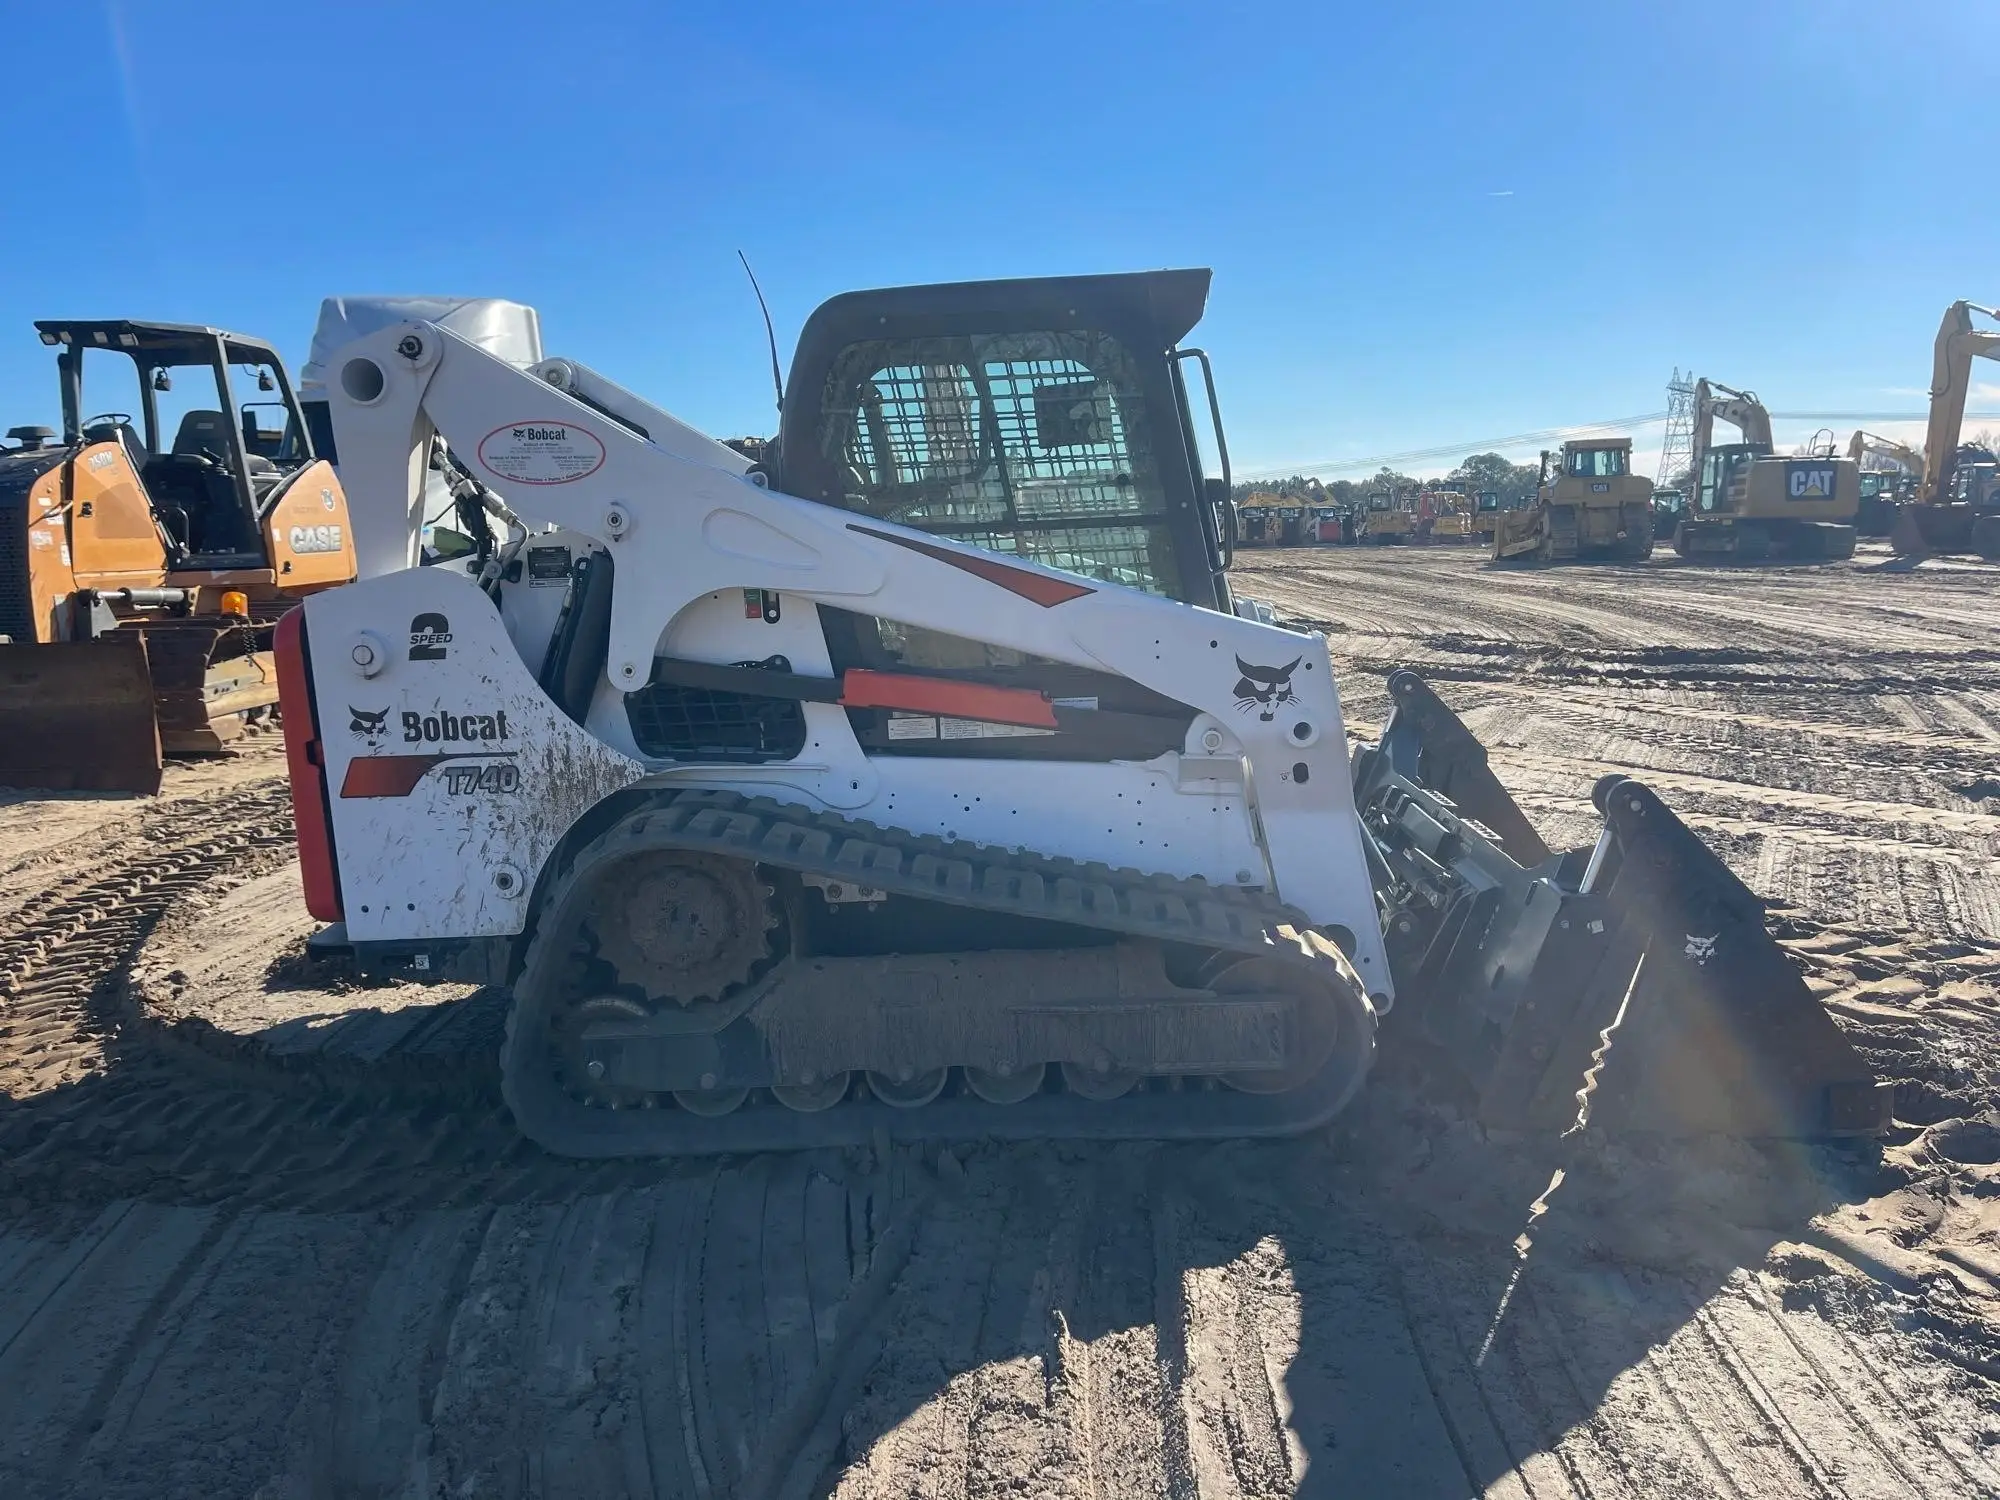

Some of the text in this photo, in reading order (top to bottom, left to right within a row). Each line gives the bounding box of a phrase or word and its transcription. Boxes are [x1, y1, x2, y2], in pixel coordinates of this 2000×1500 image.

[527, 428, 566, 440] Bobcat
[1791, 470, 1833, 497] CAT
[289, 525, 342, 553] CASE
[410, 633, 453, 645] SPEED
[402, 711, 508, 742] Bobcat
[445, 765, 519, 796] T740
